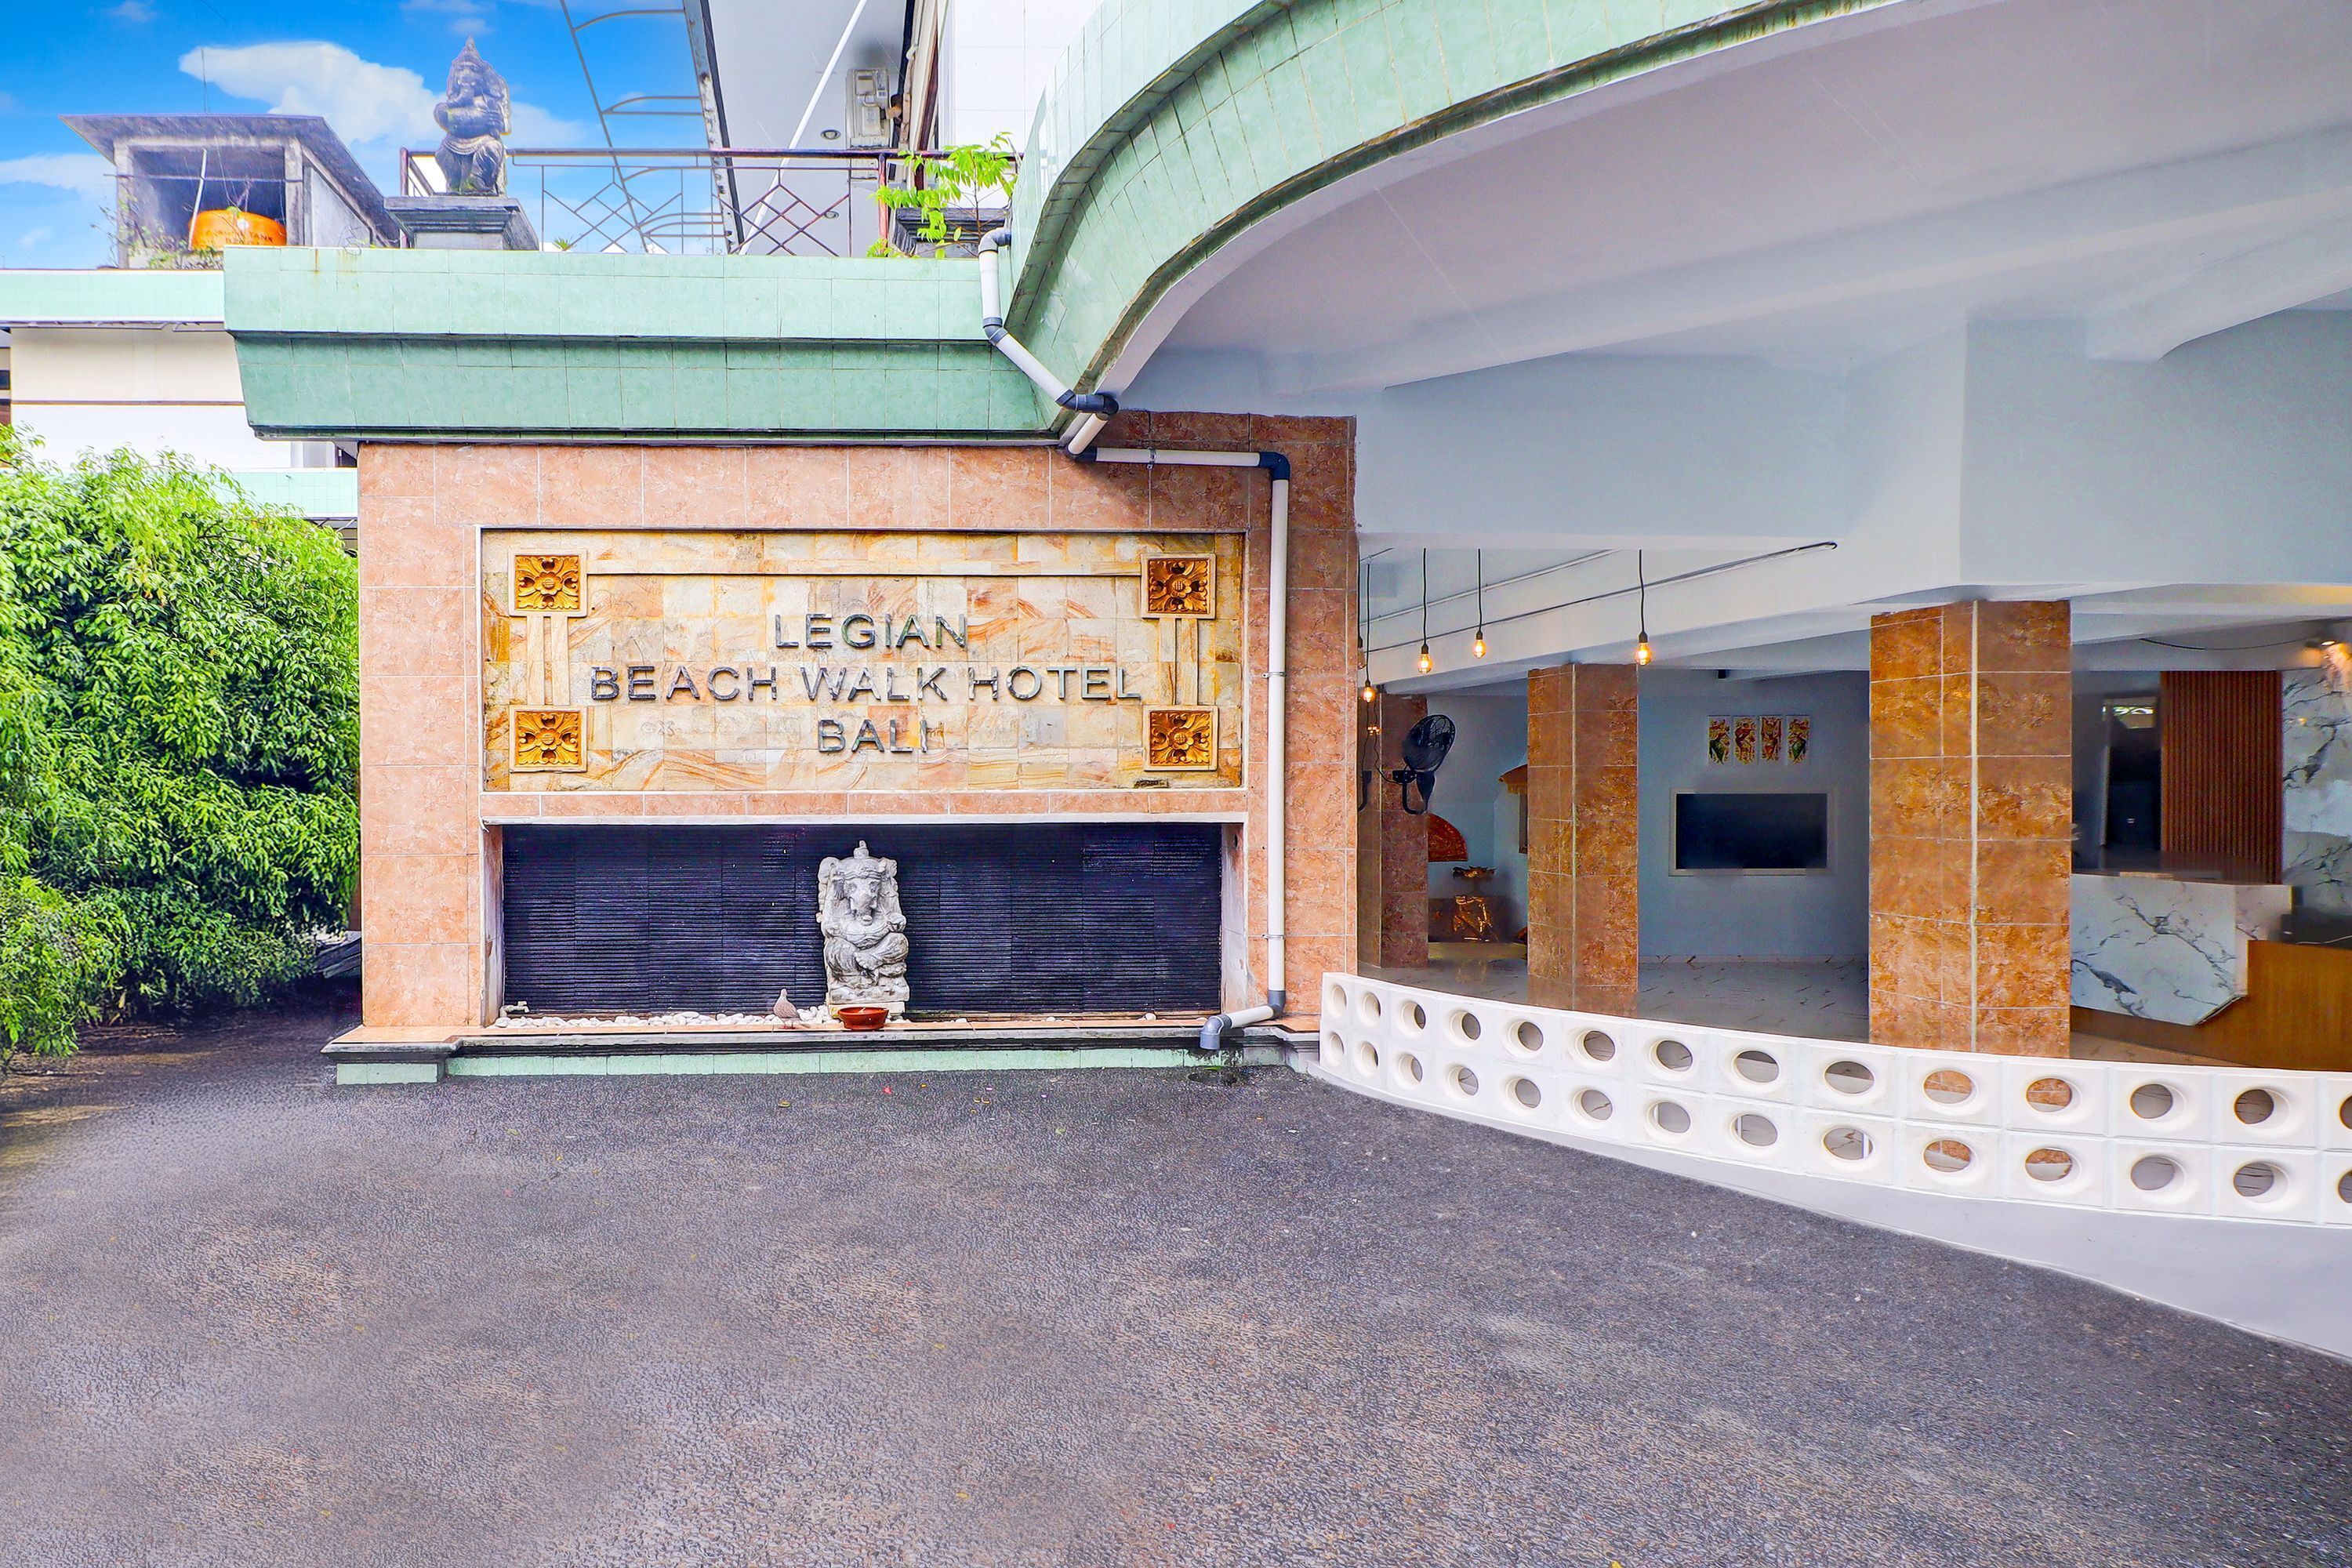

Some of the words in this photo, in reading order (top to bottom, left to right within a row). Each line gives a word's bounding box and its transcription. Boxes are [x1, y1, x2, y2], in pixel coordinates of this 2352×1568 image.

[775, 613, 967, 648] LEGIAN
[590, 665, 777, 700] BEACH
[800, 666, 948, 700] WALK
[967, 666, 1142, 700] HOTEL
[818, 719, 927, 753] BALI
